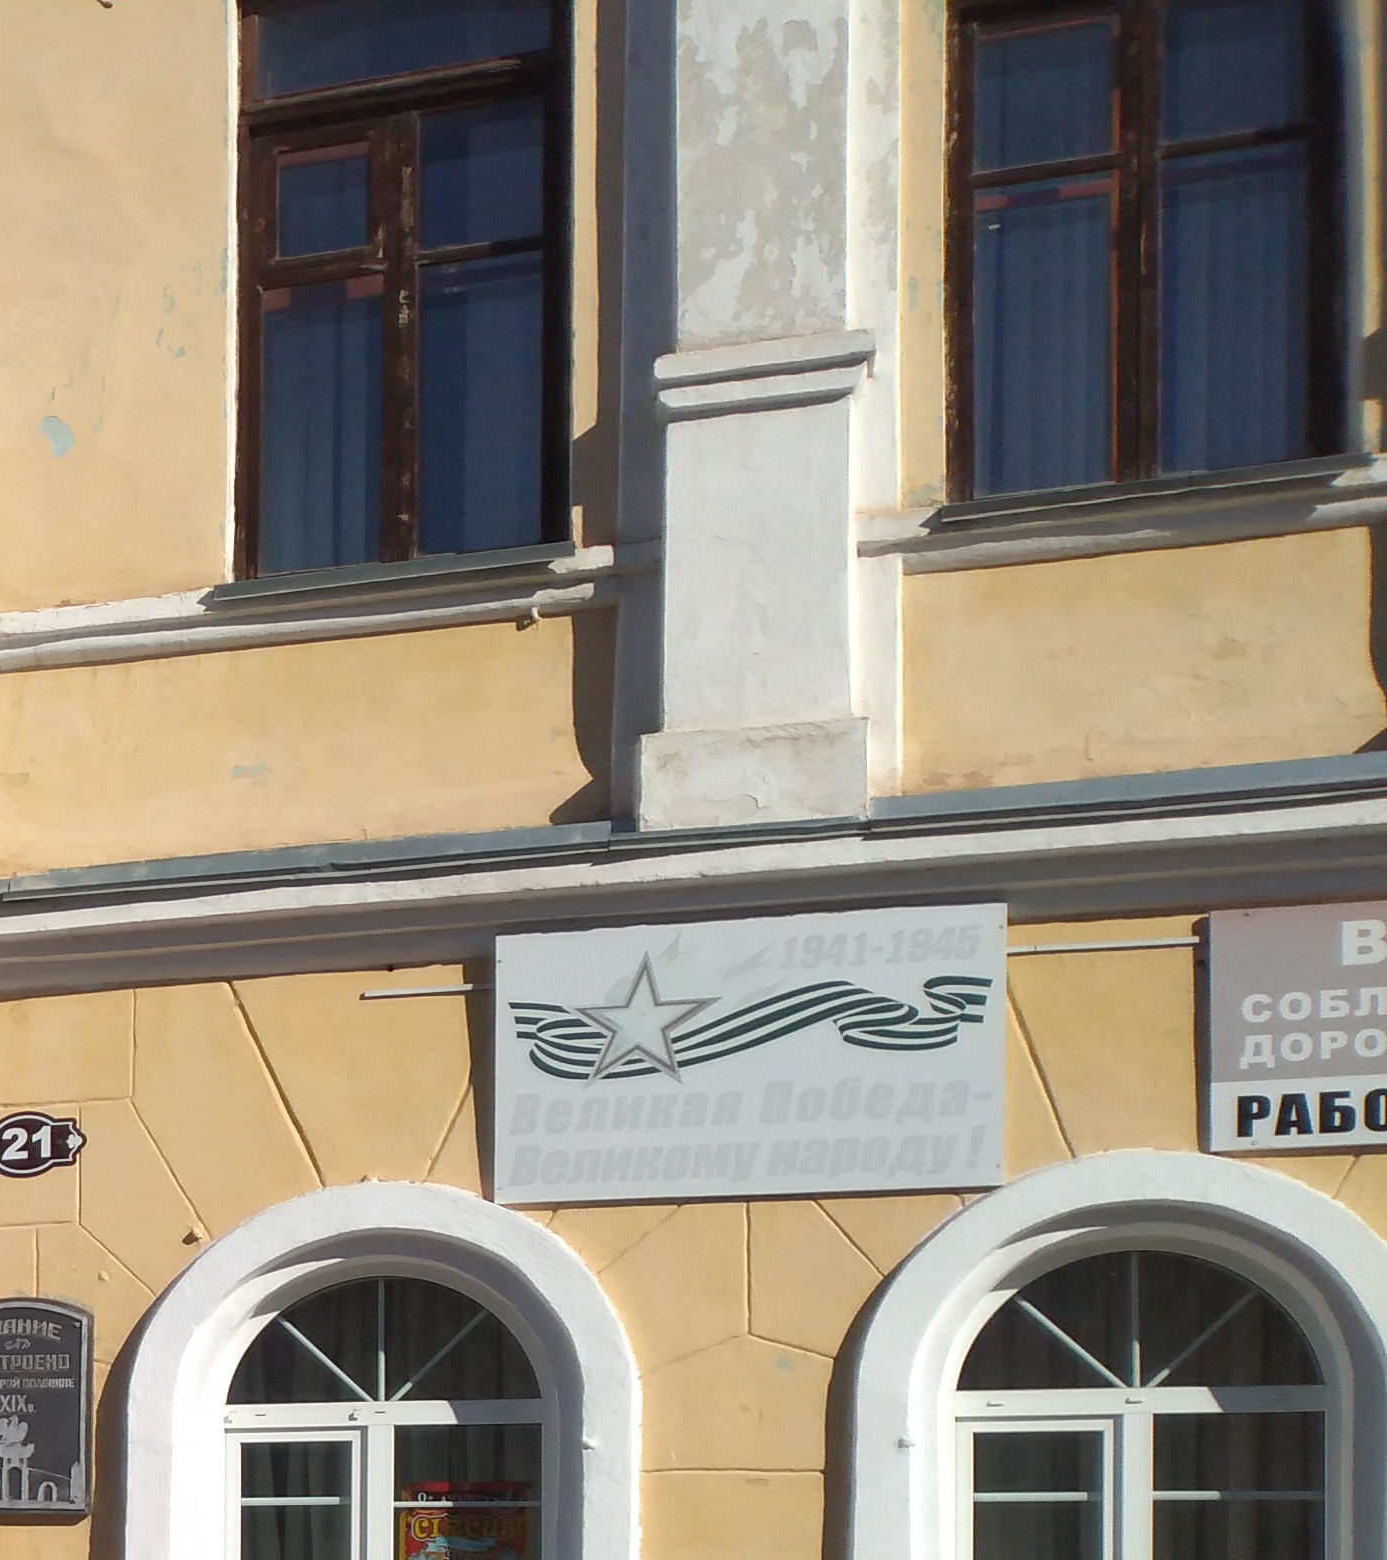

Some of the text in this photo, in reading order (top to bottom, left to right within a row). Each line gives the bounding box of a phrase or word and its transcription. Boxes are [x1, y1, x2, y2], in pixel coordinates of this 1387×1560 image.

[778, 924, 984, 970] 1941-1945
[1238, 1028, 1387, 1070] ДОРО
[509, 1089, 745, 1137] Великая
[1236, 1088, 1387, 1138] РАБО
[1, 1126, 55, 1161] 21
[508, 1138, 761, 1187] Великому
[411, 1514, 520, 1541] CIRCUS
